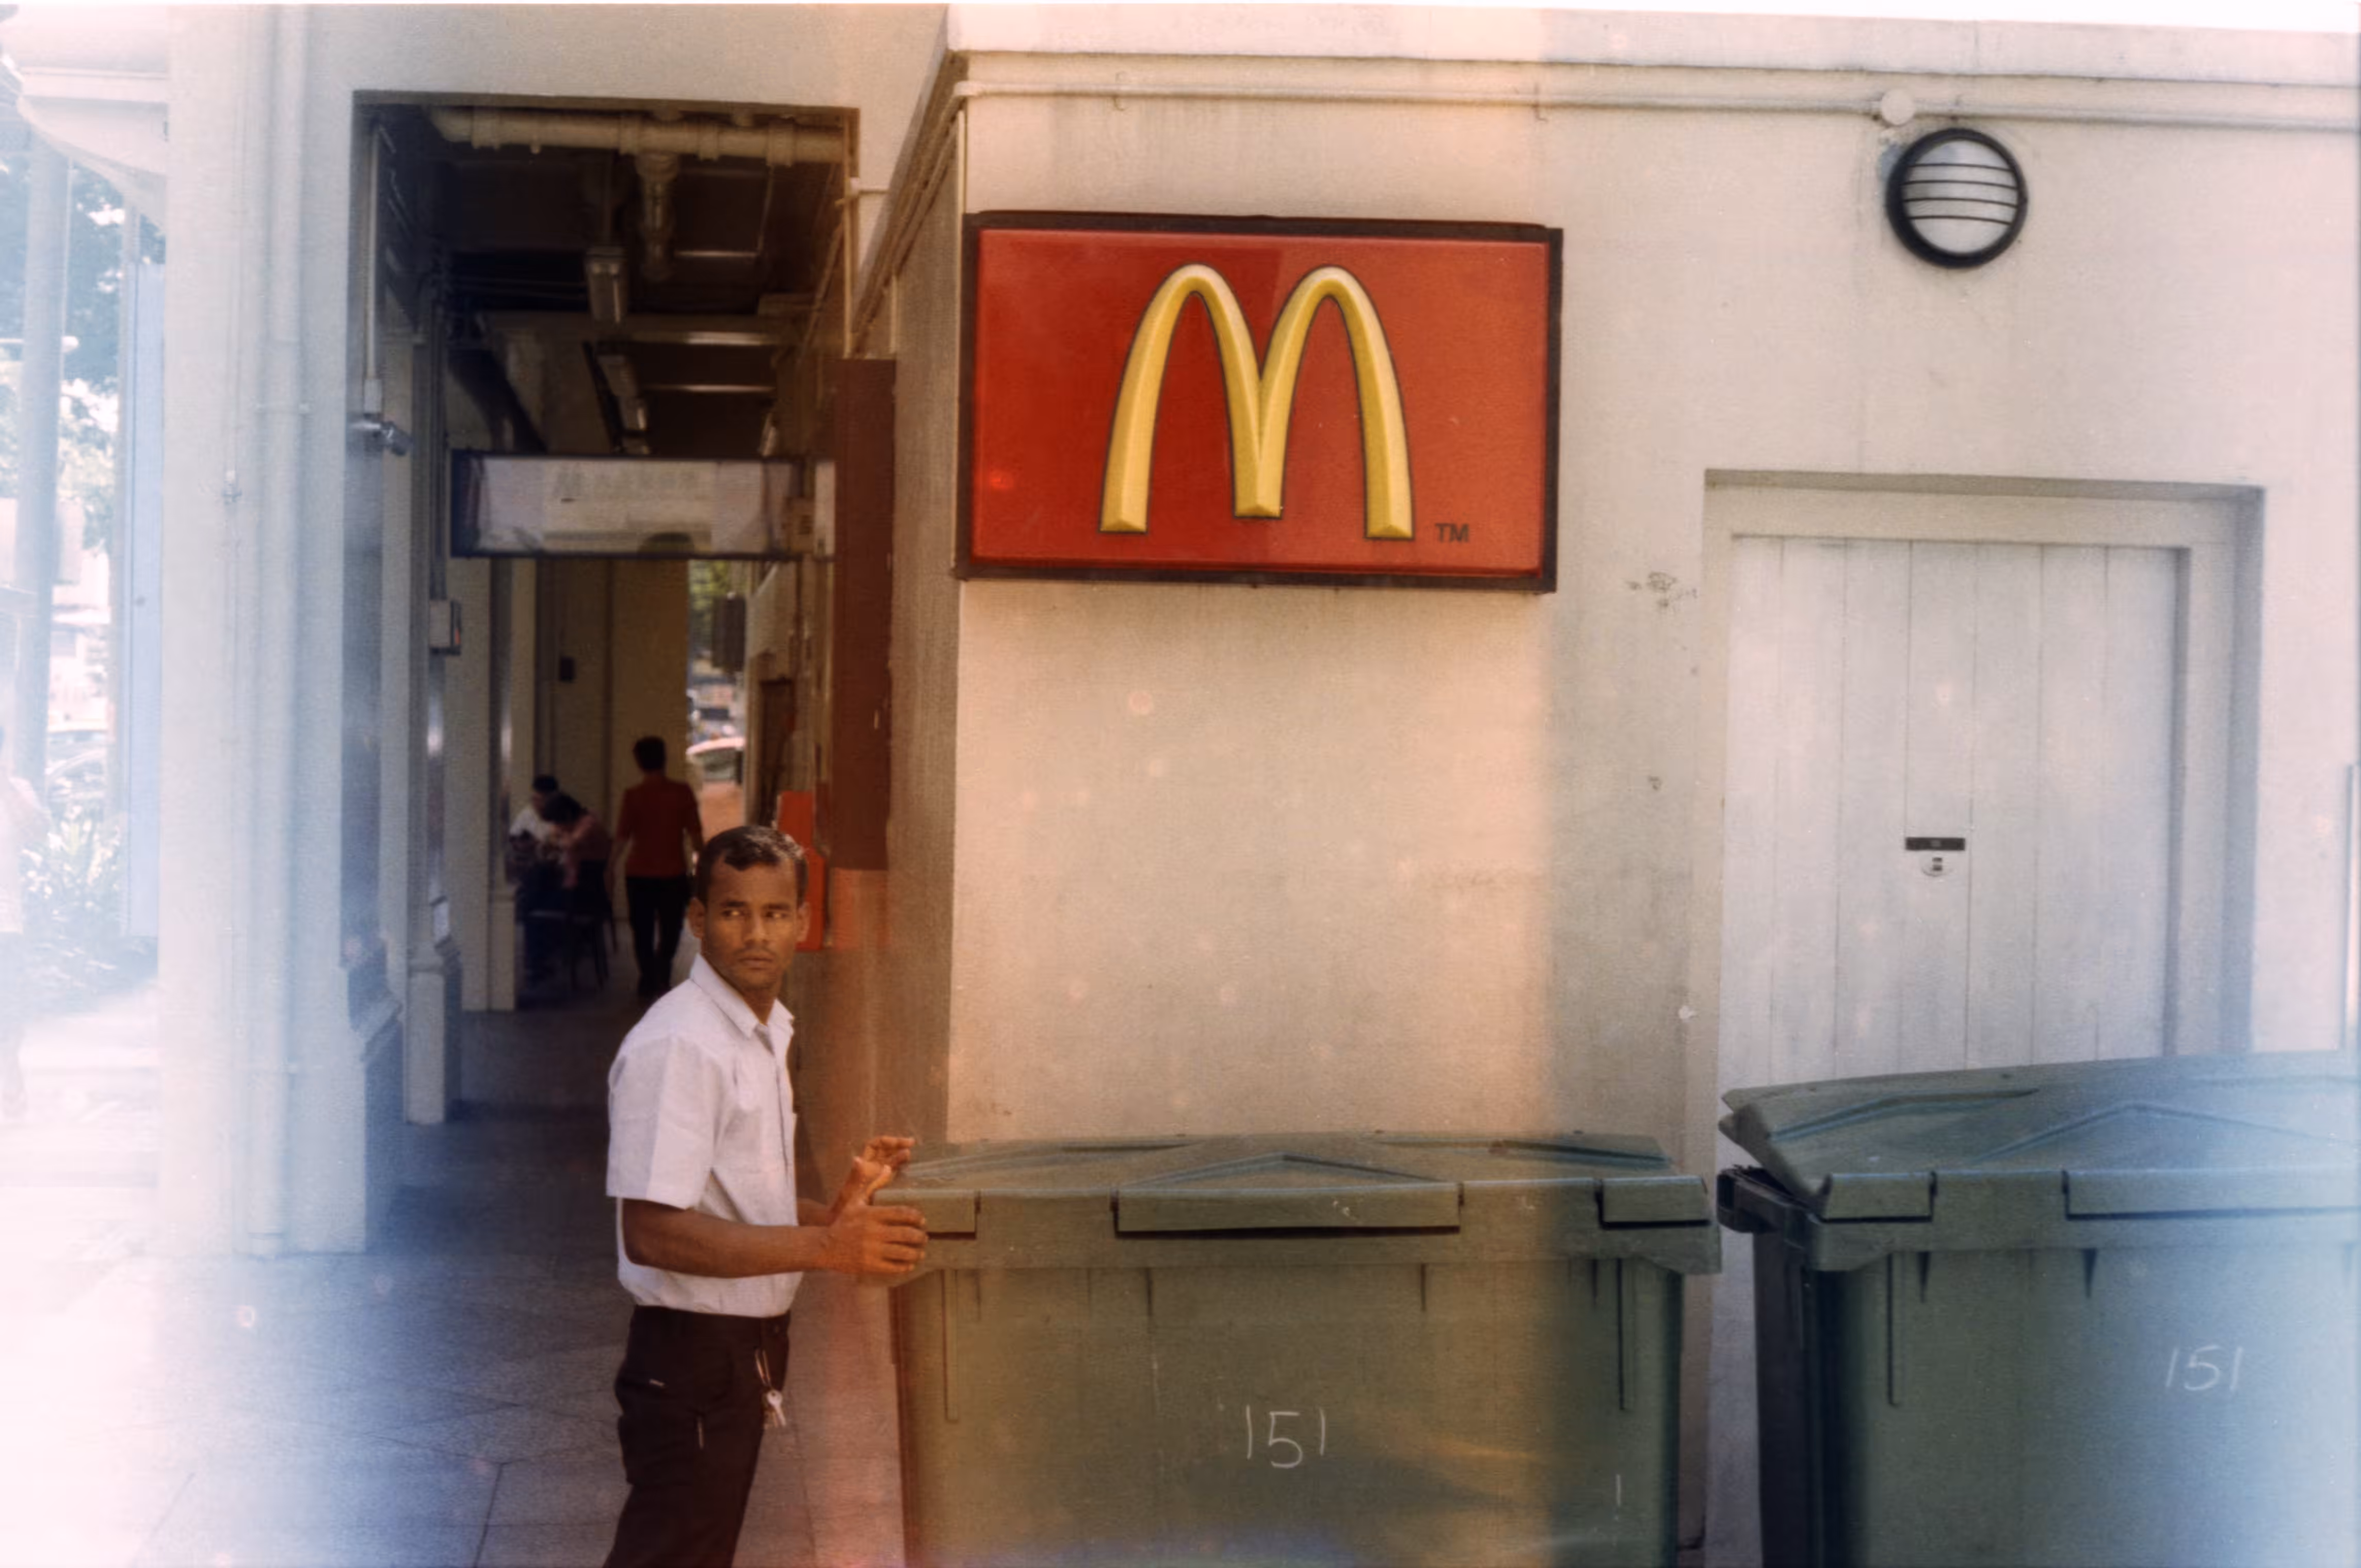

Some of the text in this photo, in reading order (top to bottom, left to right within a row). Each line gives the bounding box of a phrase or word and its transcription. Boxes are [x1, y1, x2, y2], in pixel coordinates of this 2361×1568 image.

[1099, 264, 1469, 543] M TM
[2166, 1344, 2244, 1391] 151
[1246, 1405, 1326, 1468] 151
